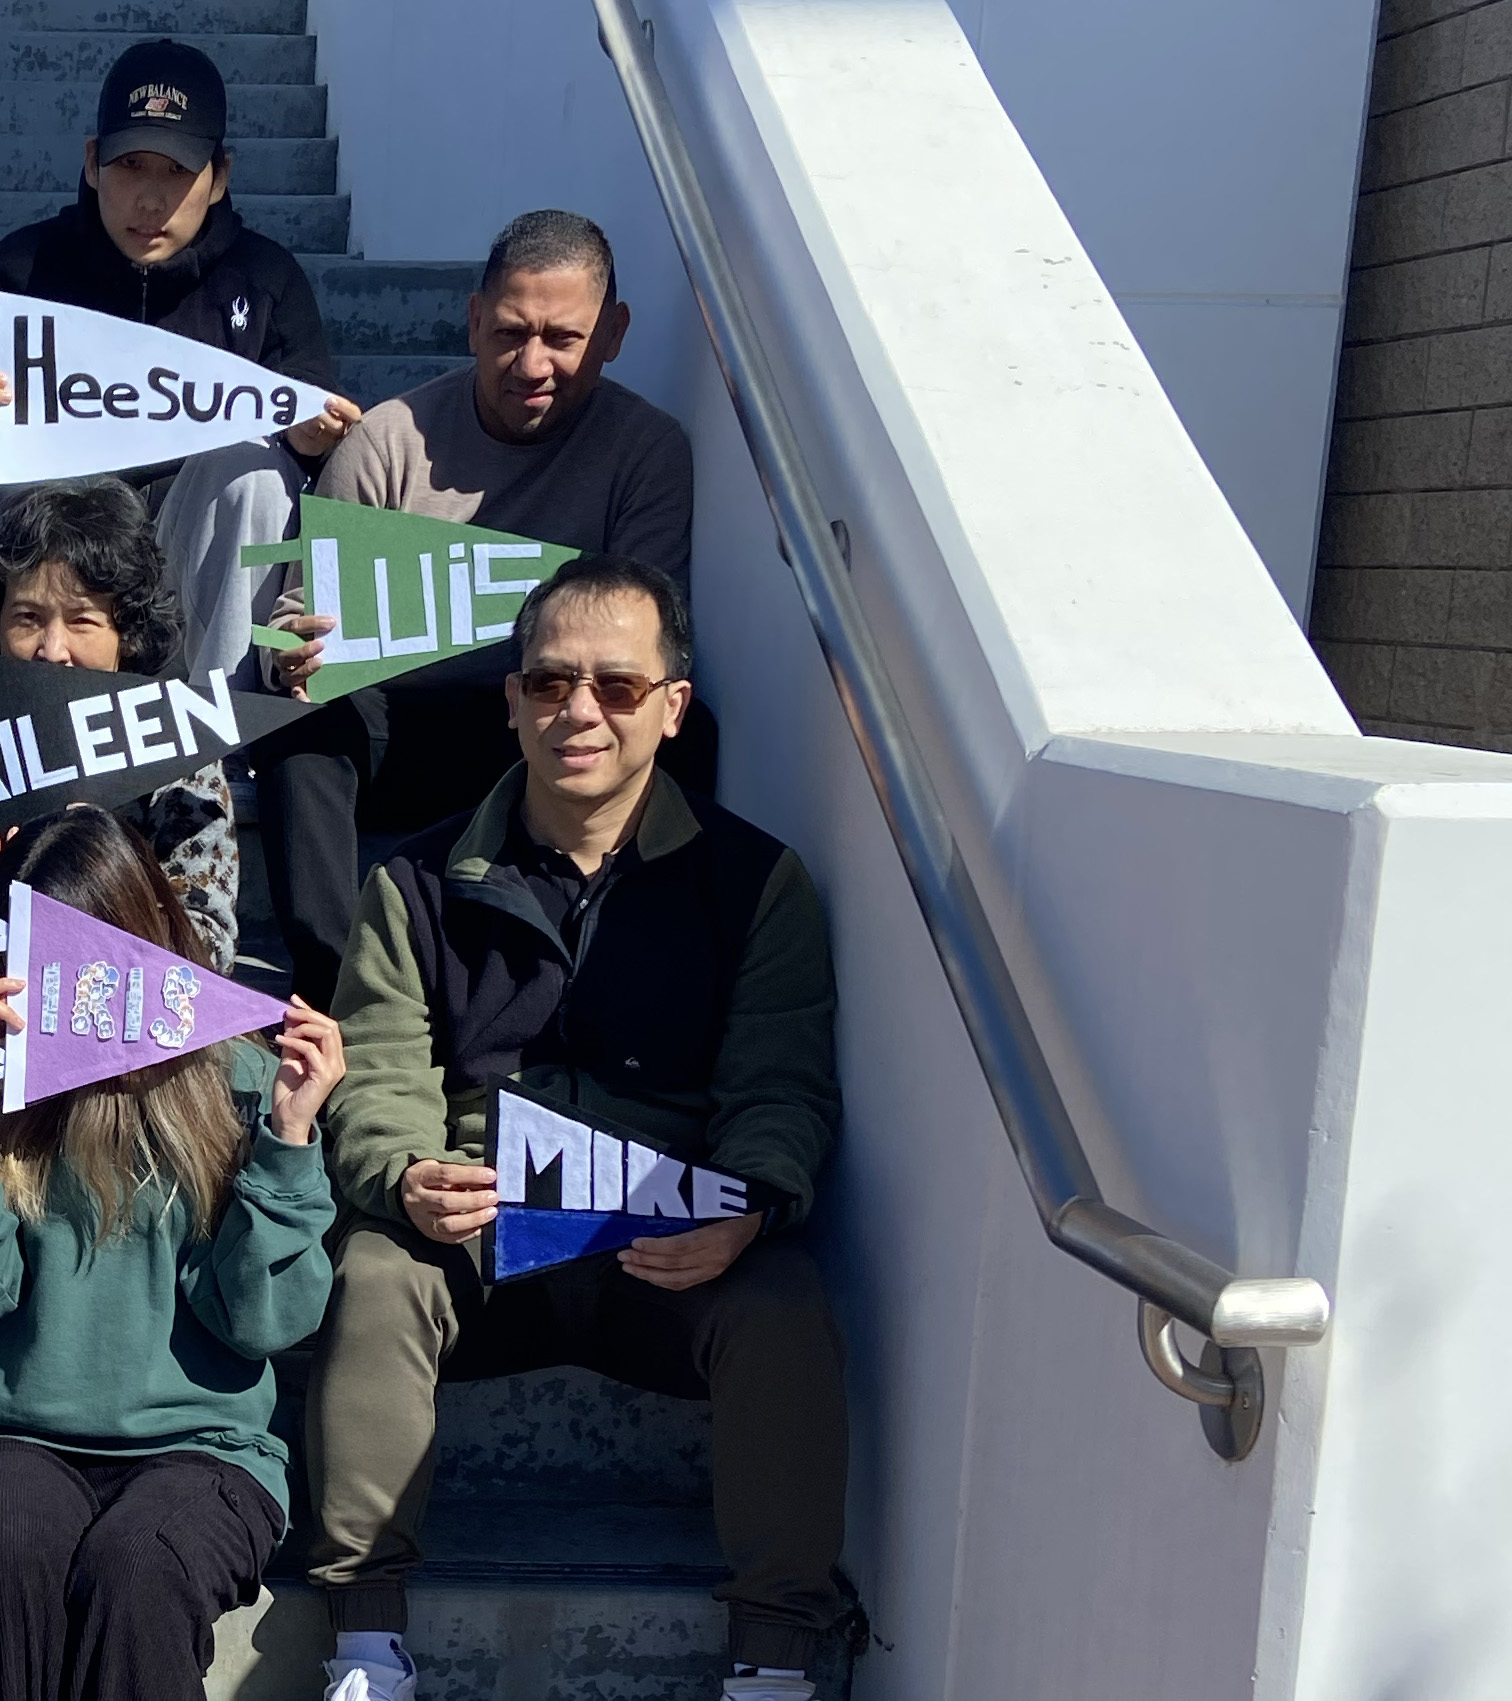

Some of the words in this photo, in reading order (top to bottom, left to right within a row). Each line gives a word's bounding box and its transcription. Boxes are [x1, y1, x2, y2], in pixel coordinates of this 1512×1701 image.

[128, 85, 147, 107] NEW
[147, 83, 188, 110] BALANCE
[40, 961, 202, 1049] IRIS
[496, 1088, 747, 1219] MIKE
